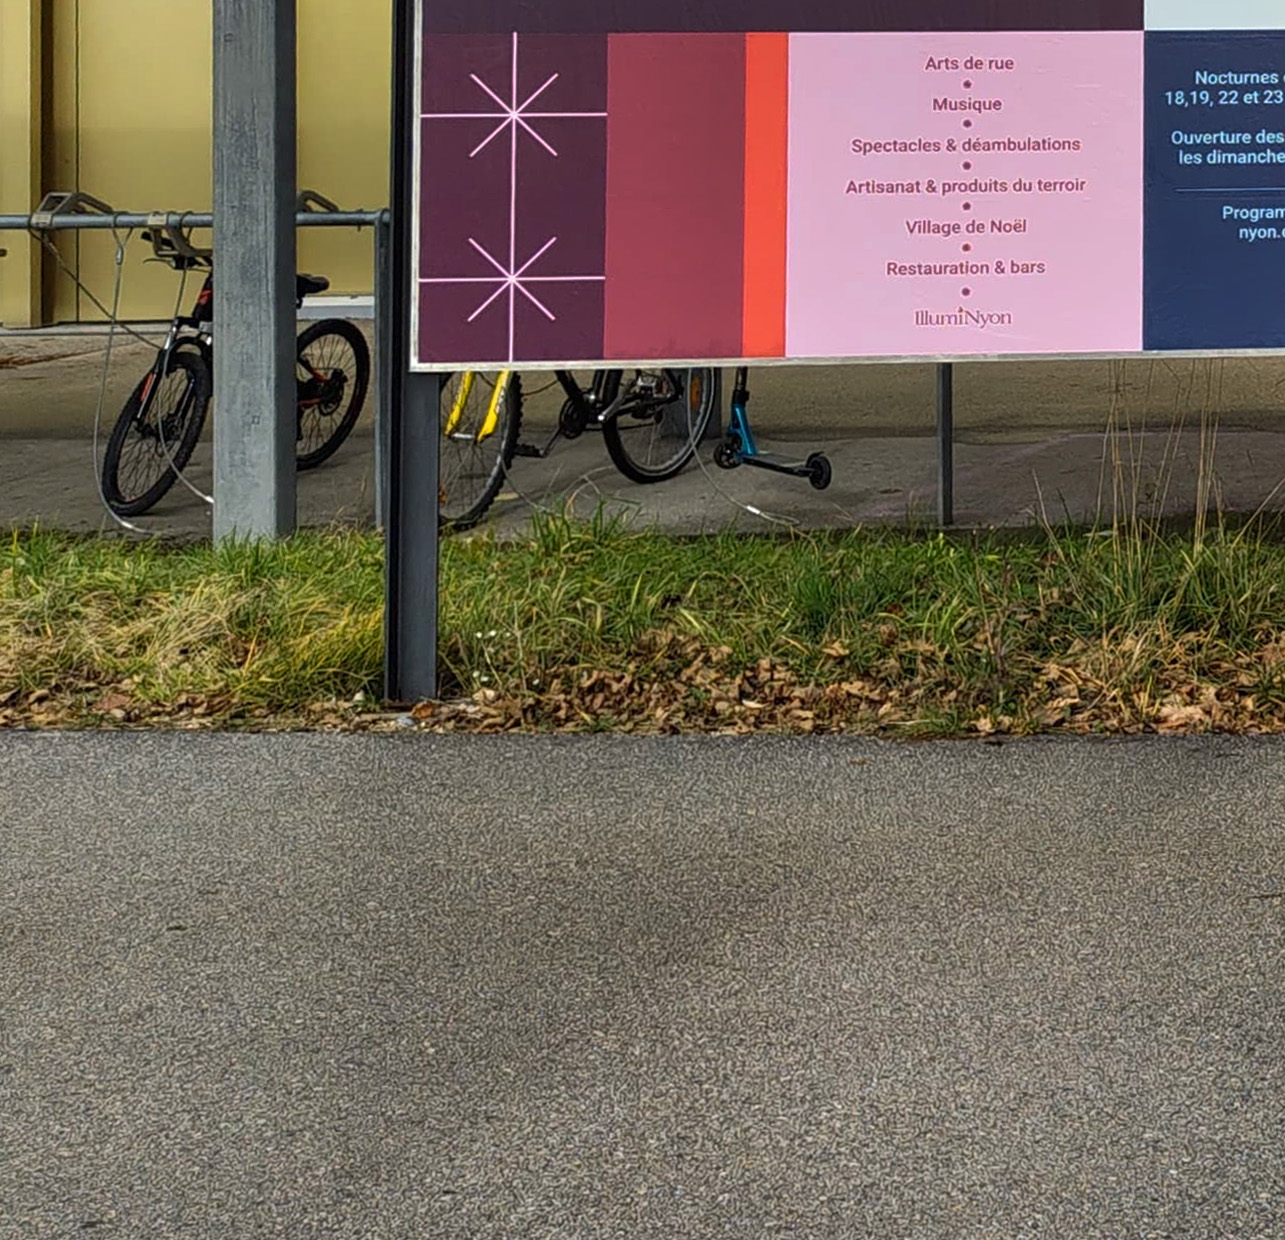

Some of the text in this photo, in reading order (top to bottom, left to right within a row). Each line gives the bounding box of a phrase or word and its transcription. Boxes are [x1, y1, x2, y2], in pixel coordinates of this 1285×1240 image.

[925, 56, 1014, 70] Arts de rue
[1196, 71, 1278, 84] Nocturnes
[1219, 90, 1238, 104] 22
[1244, 91, 1259, 104] et
[1264, 90, 1283, 103] 23
[933, 98, 1002, 113] Musique
[1172, 131, 1251, 144] Ouverture
[1256, 129, 1284, 143] des
[852, 137, 1080, 155] Spectacles & déambulations
[1180, 150, 1202, 164] les
[846, 178, 1085, 196] Artisanat & produits du terroir
[906, 219, 1026, 237] Village de Noël
[887, 260, 1045, 275] Restauration & bars
[916, 307, 1011, 328] IllumiNyon
